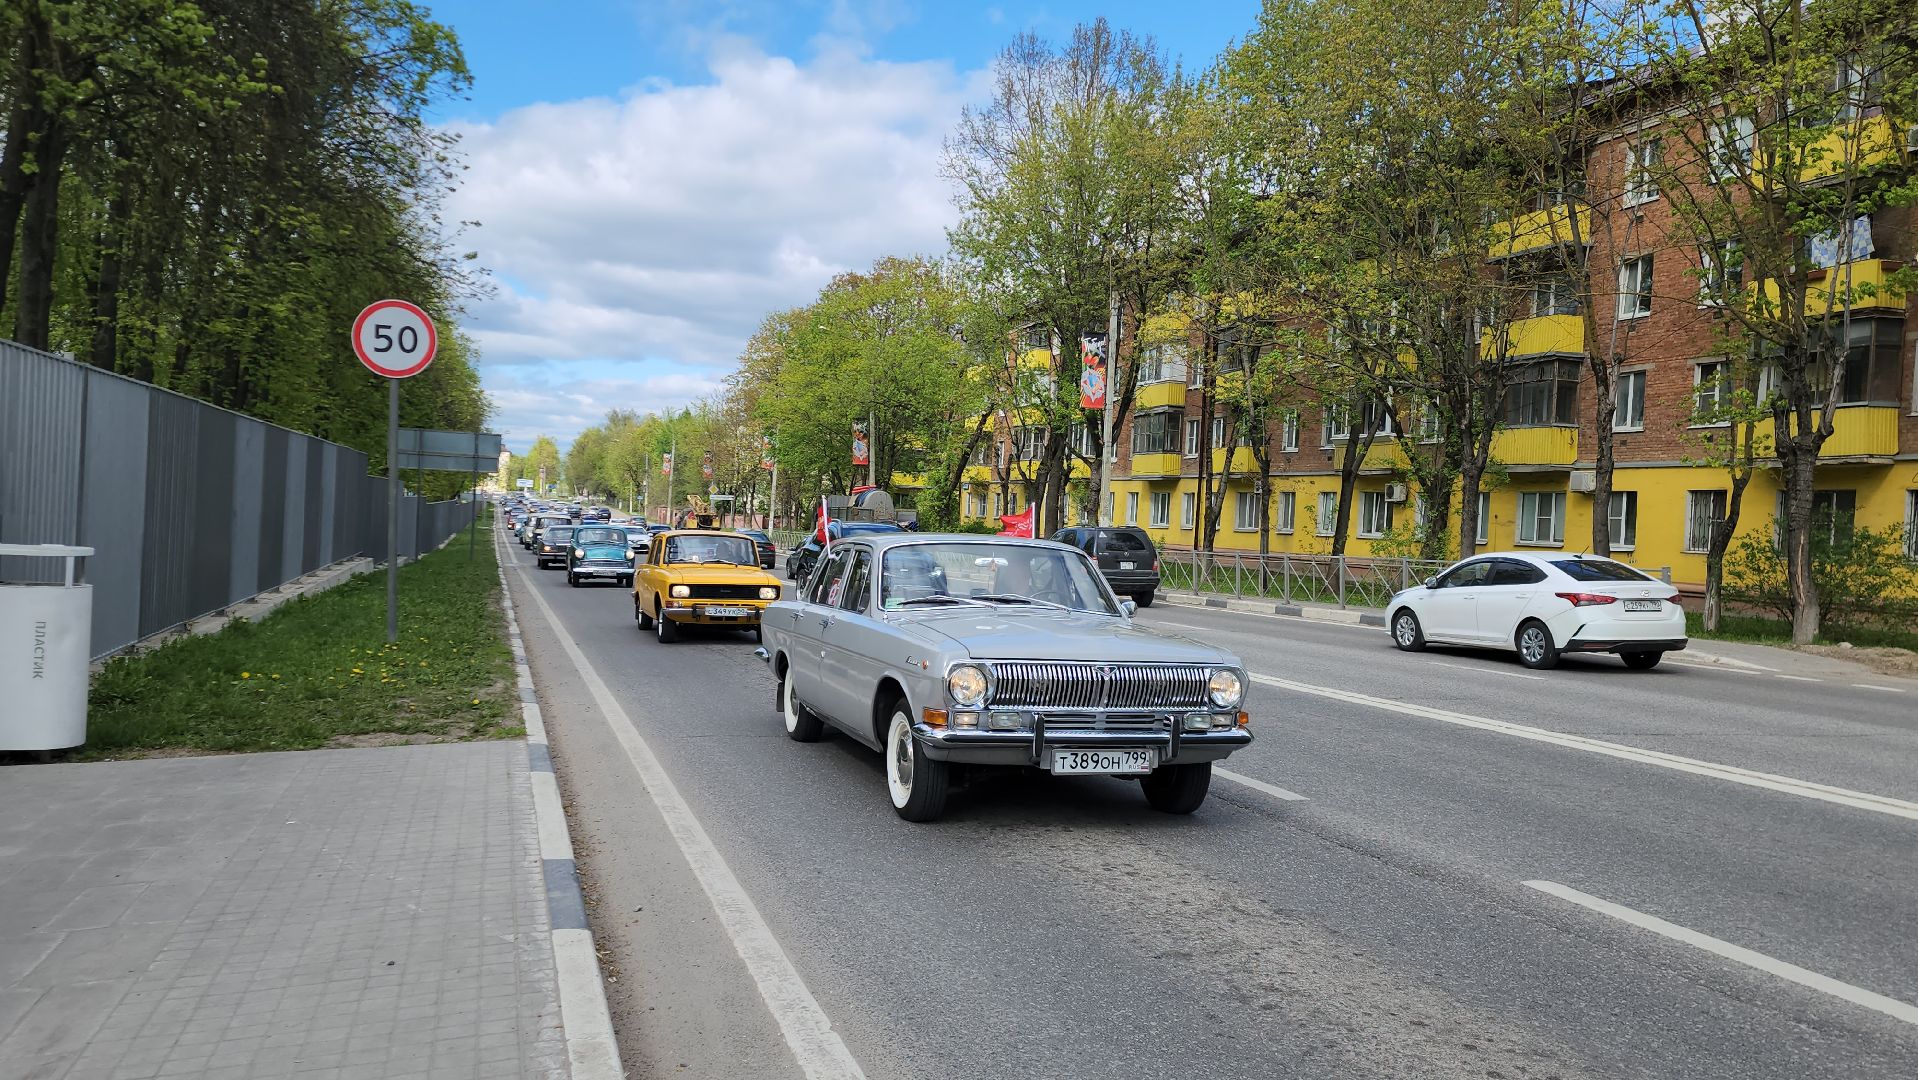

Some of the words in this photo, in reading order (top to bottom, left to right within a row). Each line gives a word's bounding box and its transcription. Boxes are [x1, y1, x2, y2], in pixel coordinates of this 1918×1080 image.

[374, 324, 418, 353] 50
[32, 621, 47, 679] ПЛАСТИК
[1059, 752, 1121, 770] Т389ОН
[1123, 751, 1147, 765] 799
